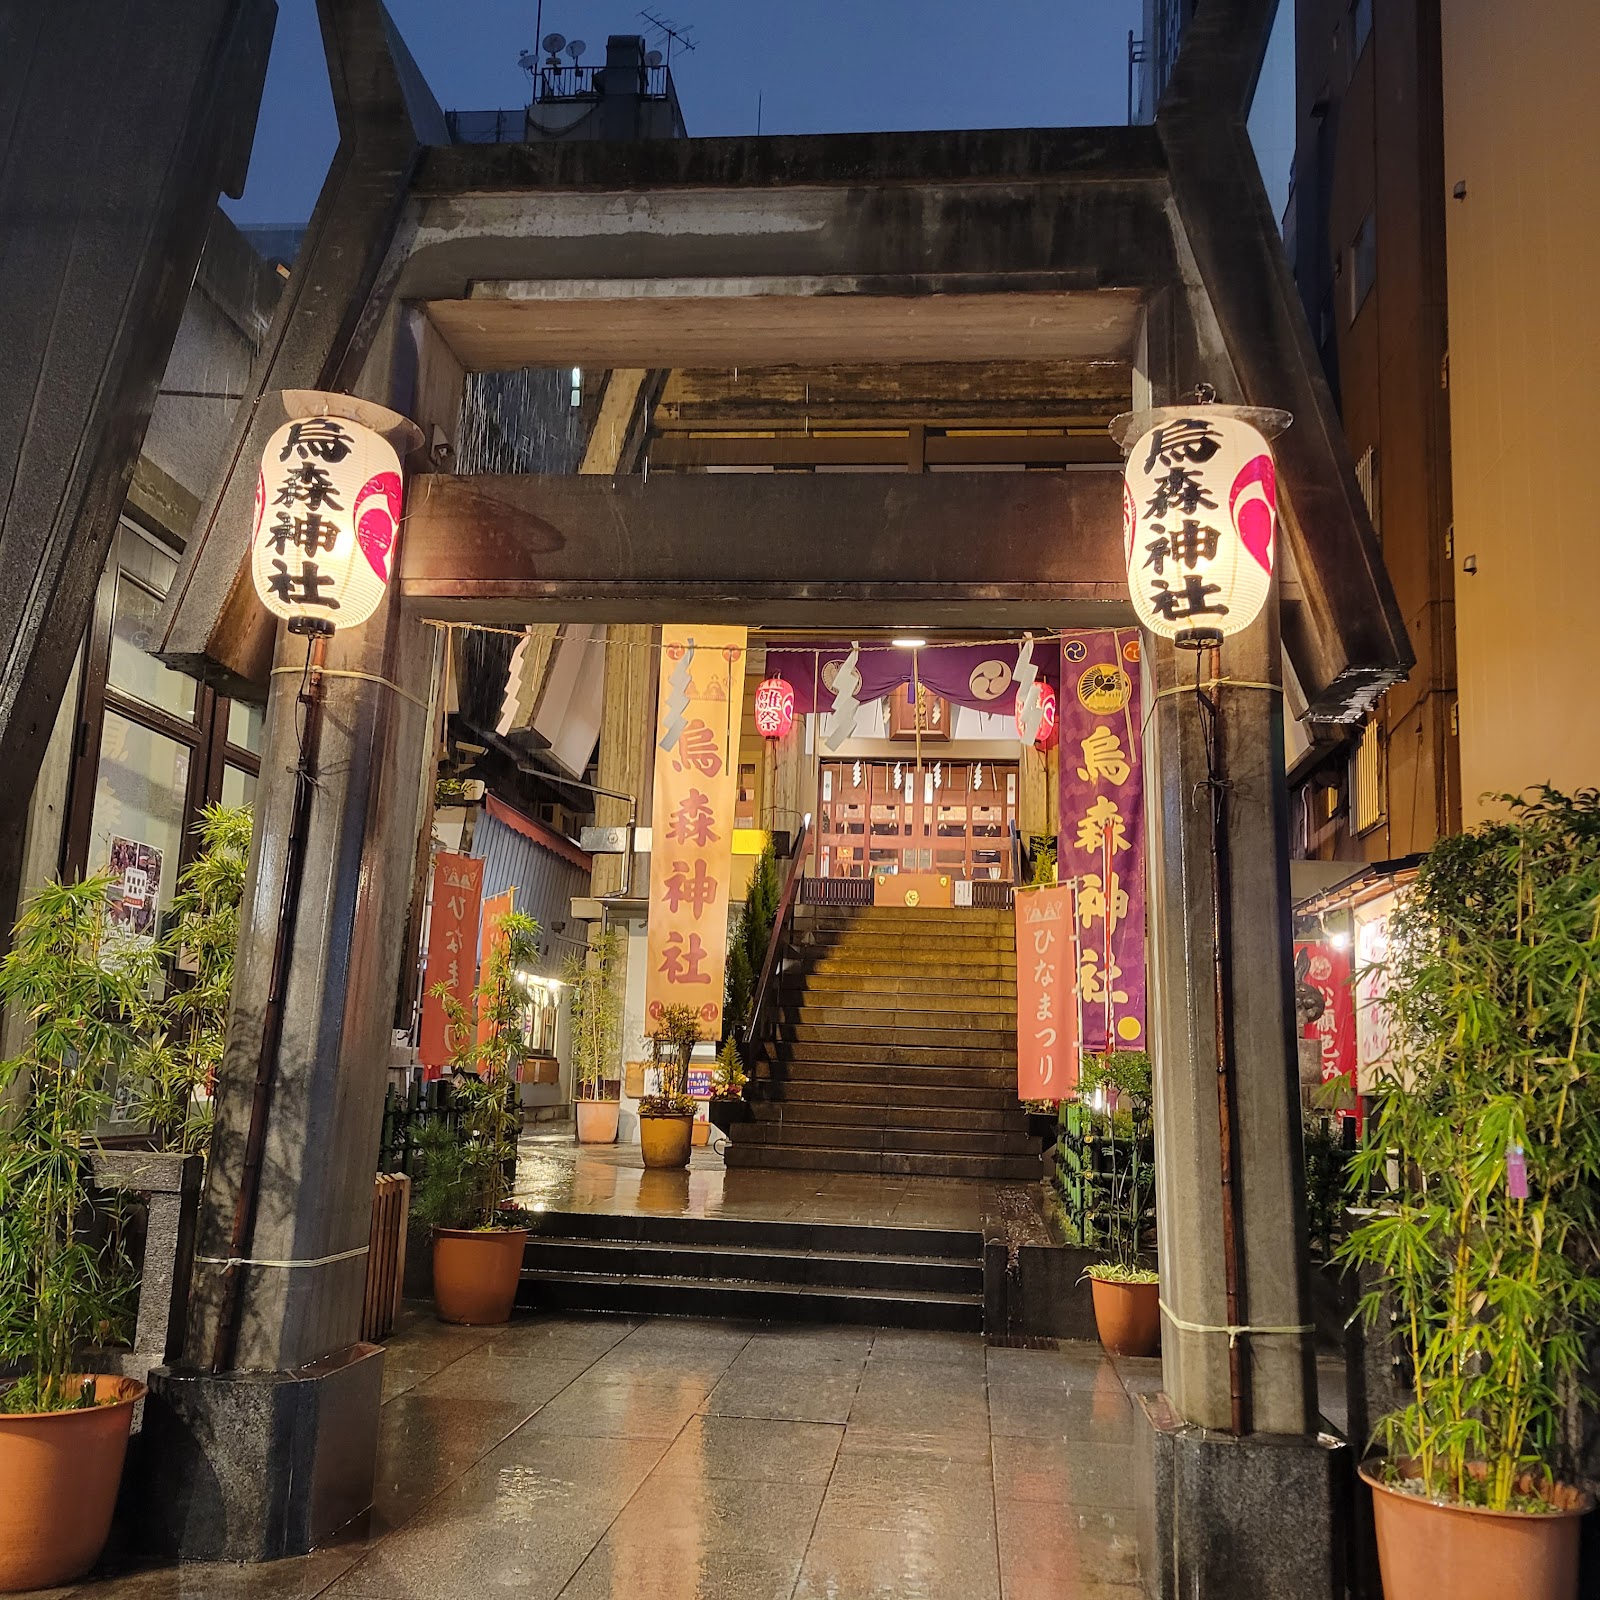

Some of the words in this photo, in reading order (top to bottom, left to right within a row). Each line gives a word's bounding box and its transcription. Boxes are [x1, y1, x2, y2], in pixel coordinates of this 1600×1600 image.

[658, 718, 723, 985] 烏森神社
[1033, 929, 1057, 1086] ひなまつり
